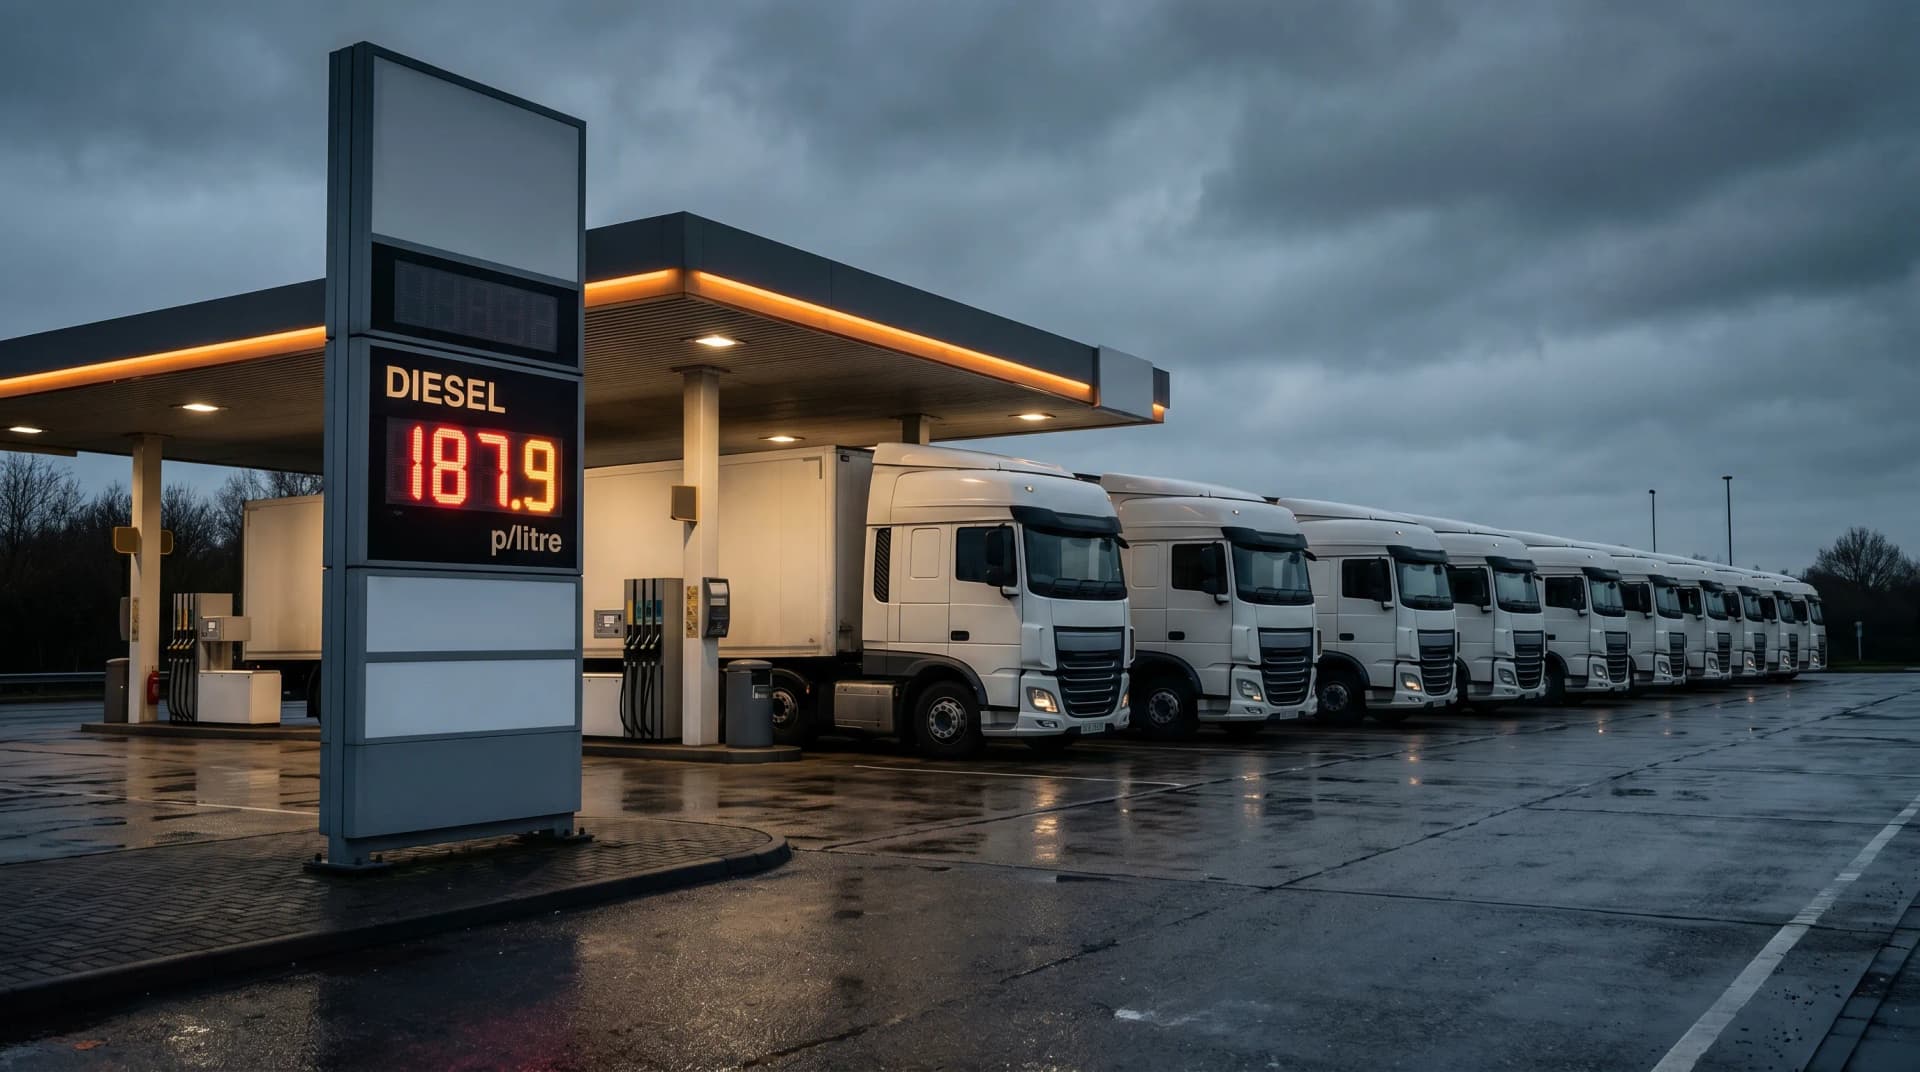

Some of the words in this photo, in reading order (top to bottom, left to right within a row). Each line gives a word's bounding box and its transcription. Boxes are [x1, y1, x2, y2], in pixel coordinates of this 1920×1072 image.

[386, 365, 506, 414] DIESEL
[412, 425, 556, 513] 187.9
[491, 525, 562, 556] p/litre
